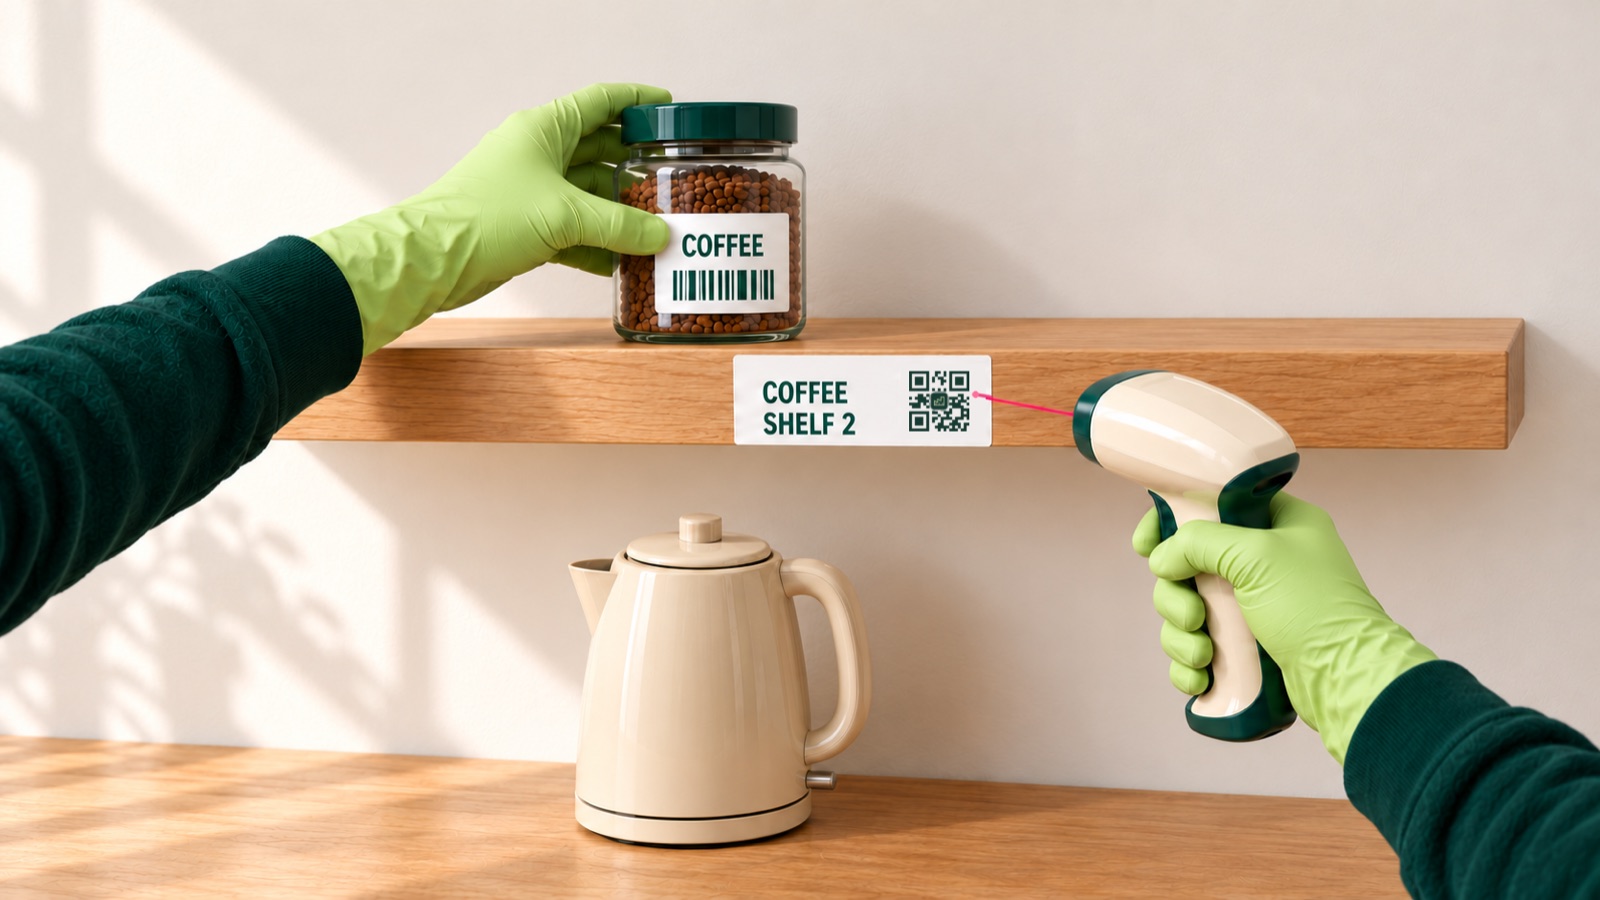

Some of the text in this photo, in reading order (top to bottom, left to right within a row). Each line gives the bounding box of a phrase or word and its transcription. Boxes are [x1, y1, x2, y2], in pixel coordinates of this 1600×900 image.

[682, 233, 764, 257] COFFEE
[763, 380, 848, 404] COFFEE
[763, 412, 856, 435] SHELF 2
